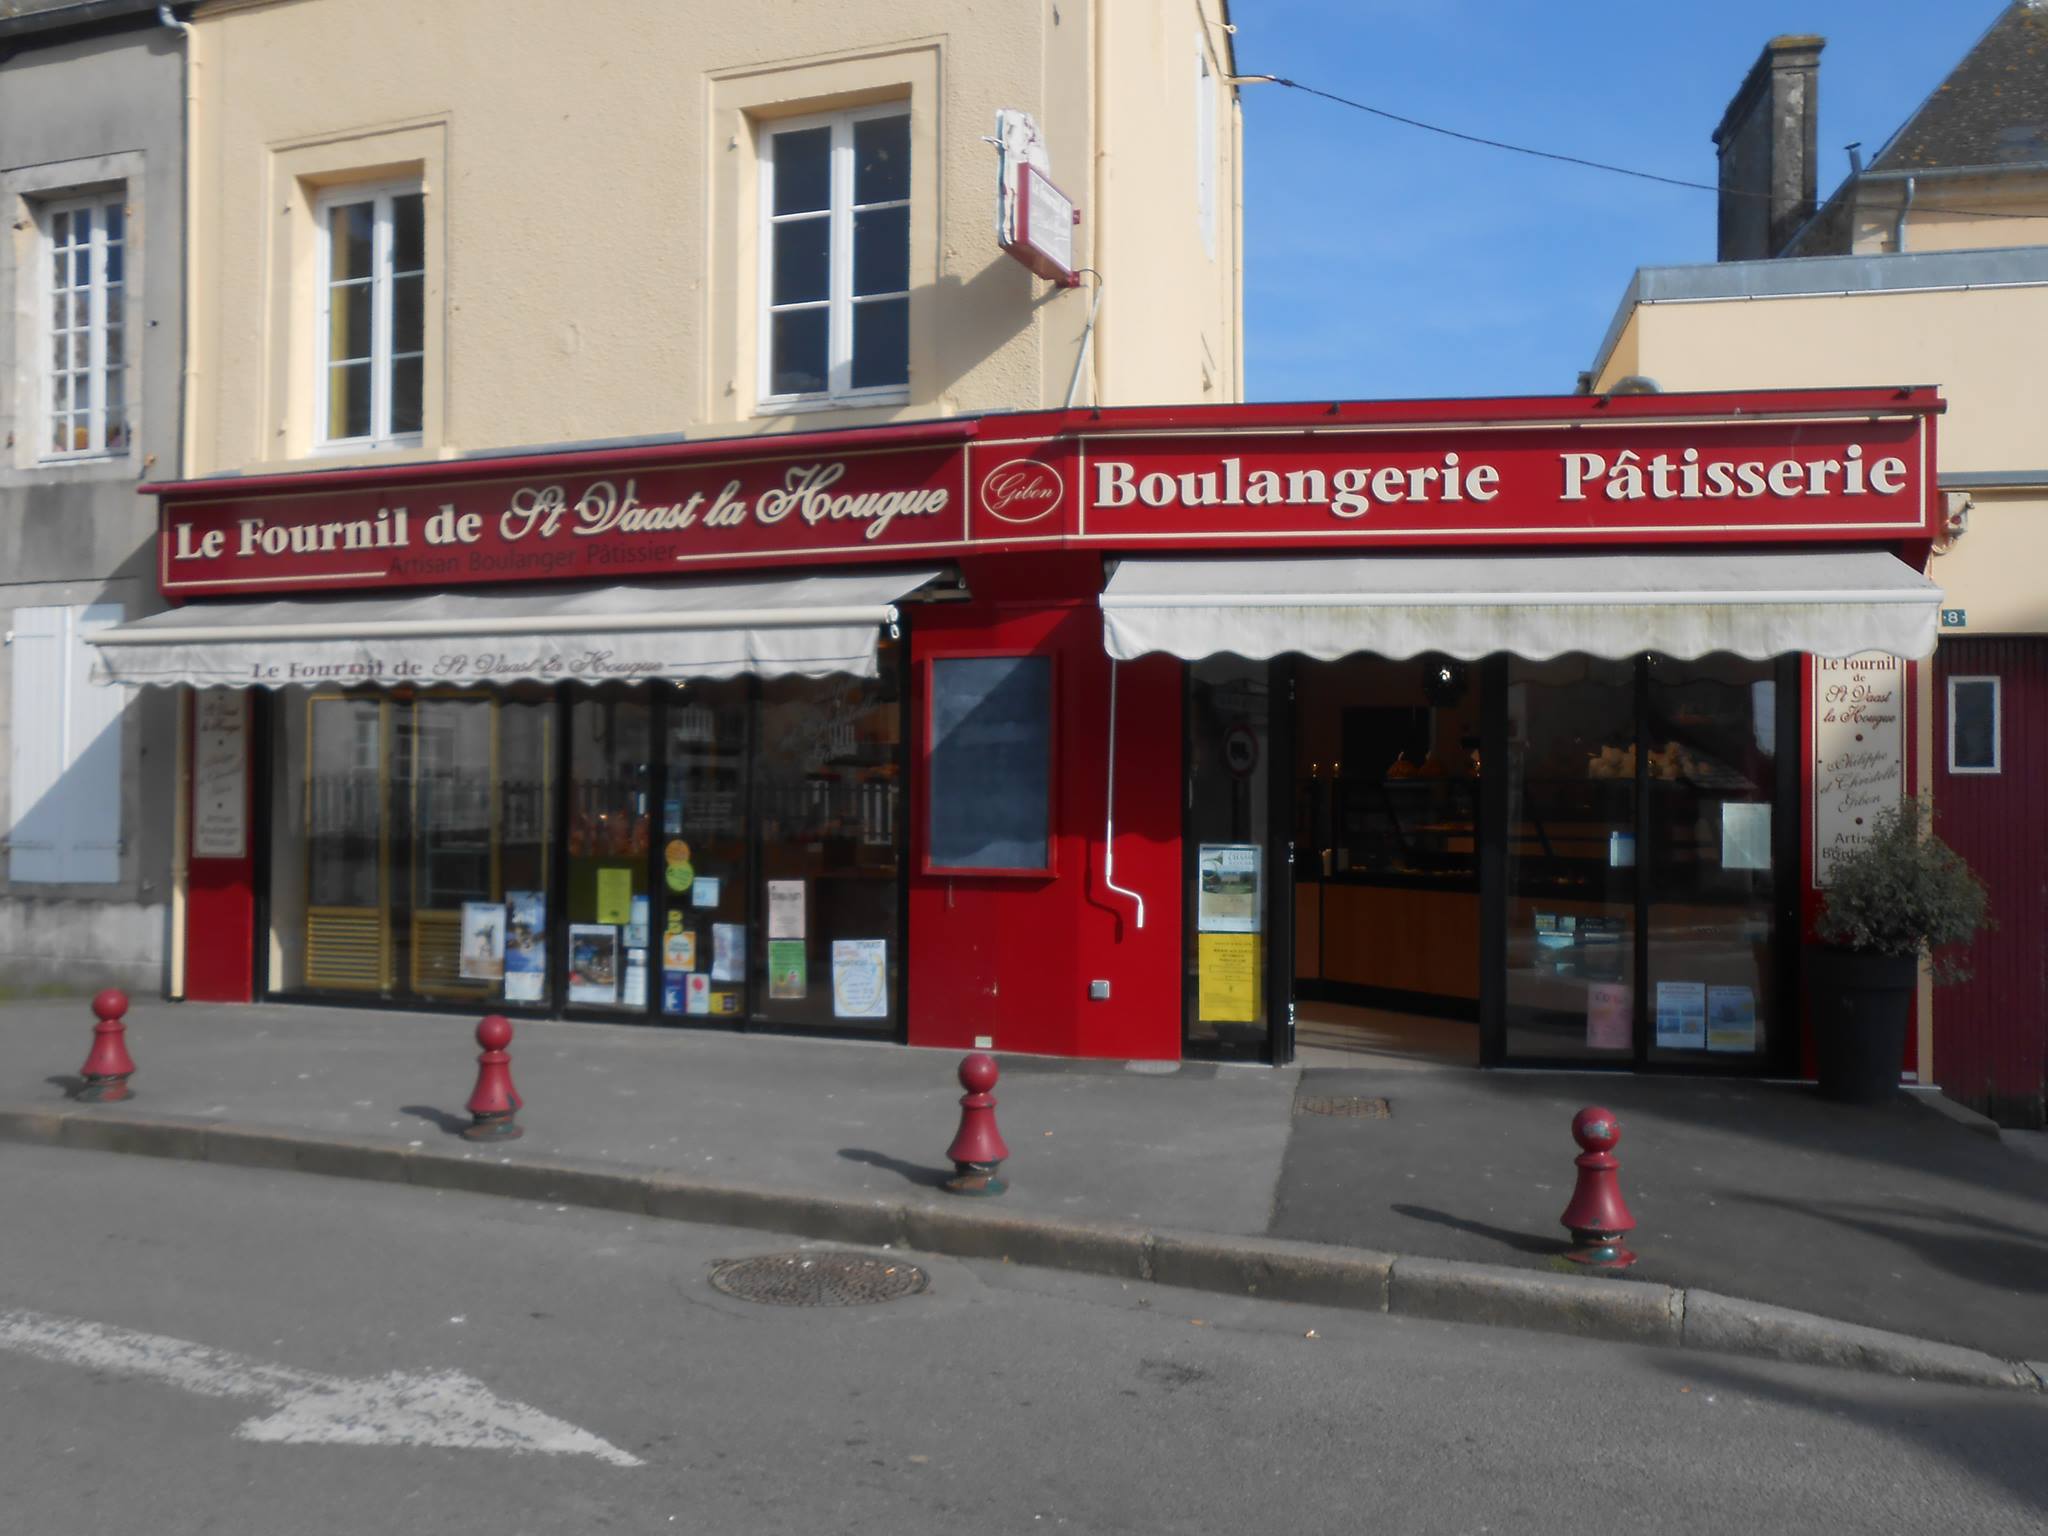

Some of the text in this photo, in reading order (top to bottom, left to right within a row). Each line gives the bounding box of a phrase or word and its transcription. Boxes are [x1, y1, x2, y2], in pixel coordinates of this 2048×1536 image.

[990, 473, 1054, 510] Gibon
[1093, 444, 1907, 518] Boulangerie Pâtisserie
[174, 462, 950, 560] Le Fournil de St Vaast la Hougue
[389, 541, 677, 574] Artisan Boulanger Pâtissier
[1948, 611, 1959, 624] 8
[252, 662, 280, 678] Le
[289, 659, 384, 679] Fournil
[392, 659, 423, 677] de
[432, 653, 468, 676] St
[568, 650, 664, 679] Hougue
[1822, 656, 1897, 671] Le Fournil
[1853, 674, 1866, 682] de
[1823, 707, 1836, 723] la
